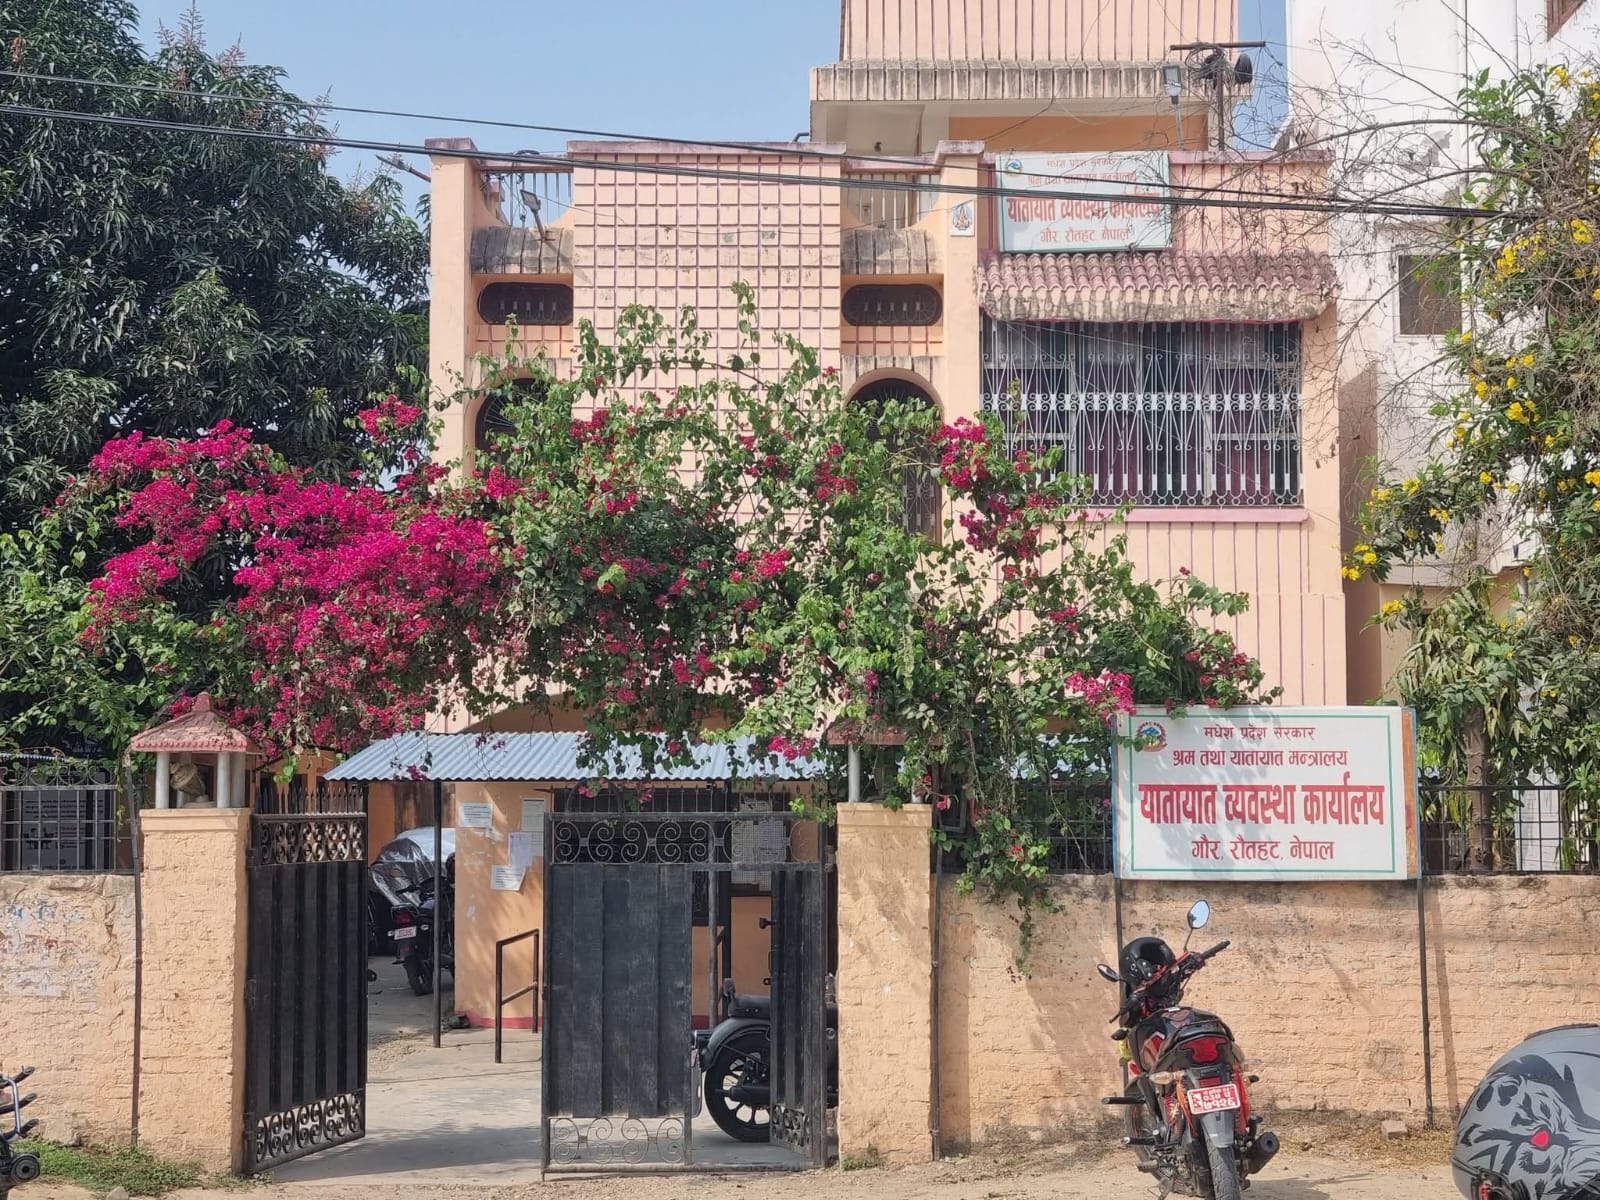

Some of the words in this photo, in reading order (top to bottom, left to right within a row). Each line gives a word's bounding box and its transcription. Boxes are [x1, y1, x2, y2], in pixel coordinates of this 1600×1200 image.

[1006, 196, 1056, 222] यातायात
[1203, 724, 1235, 740] मधेश
[1240, 724, 1267, 741] प्रदेश
[1273, 727, 1316, 741] सरकार
[1172, 750, 1196, 767] श्रम
[1200, 750, 1226, 766] तथा
[1230, 750, 1284, 767] यातायात
[1288, 750, 1348, 767] मन्त्रालय
[1138, 784, 1218, 825] यातायात
[1222, 784, 1297, 825] व्यवस्था
[1301, 771, 1385, 825] कार्यालय
[1289, 835, 1335, 860] नेपाल
